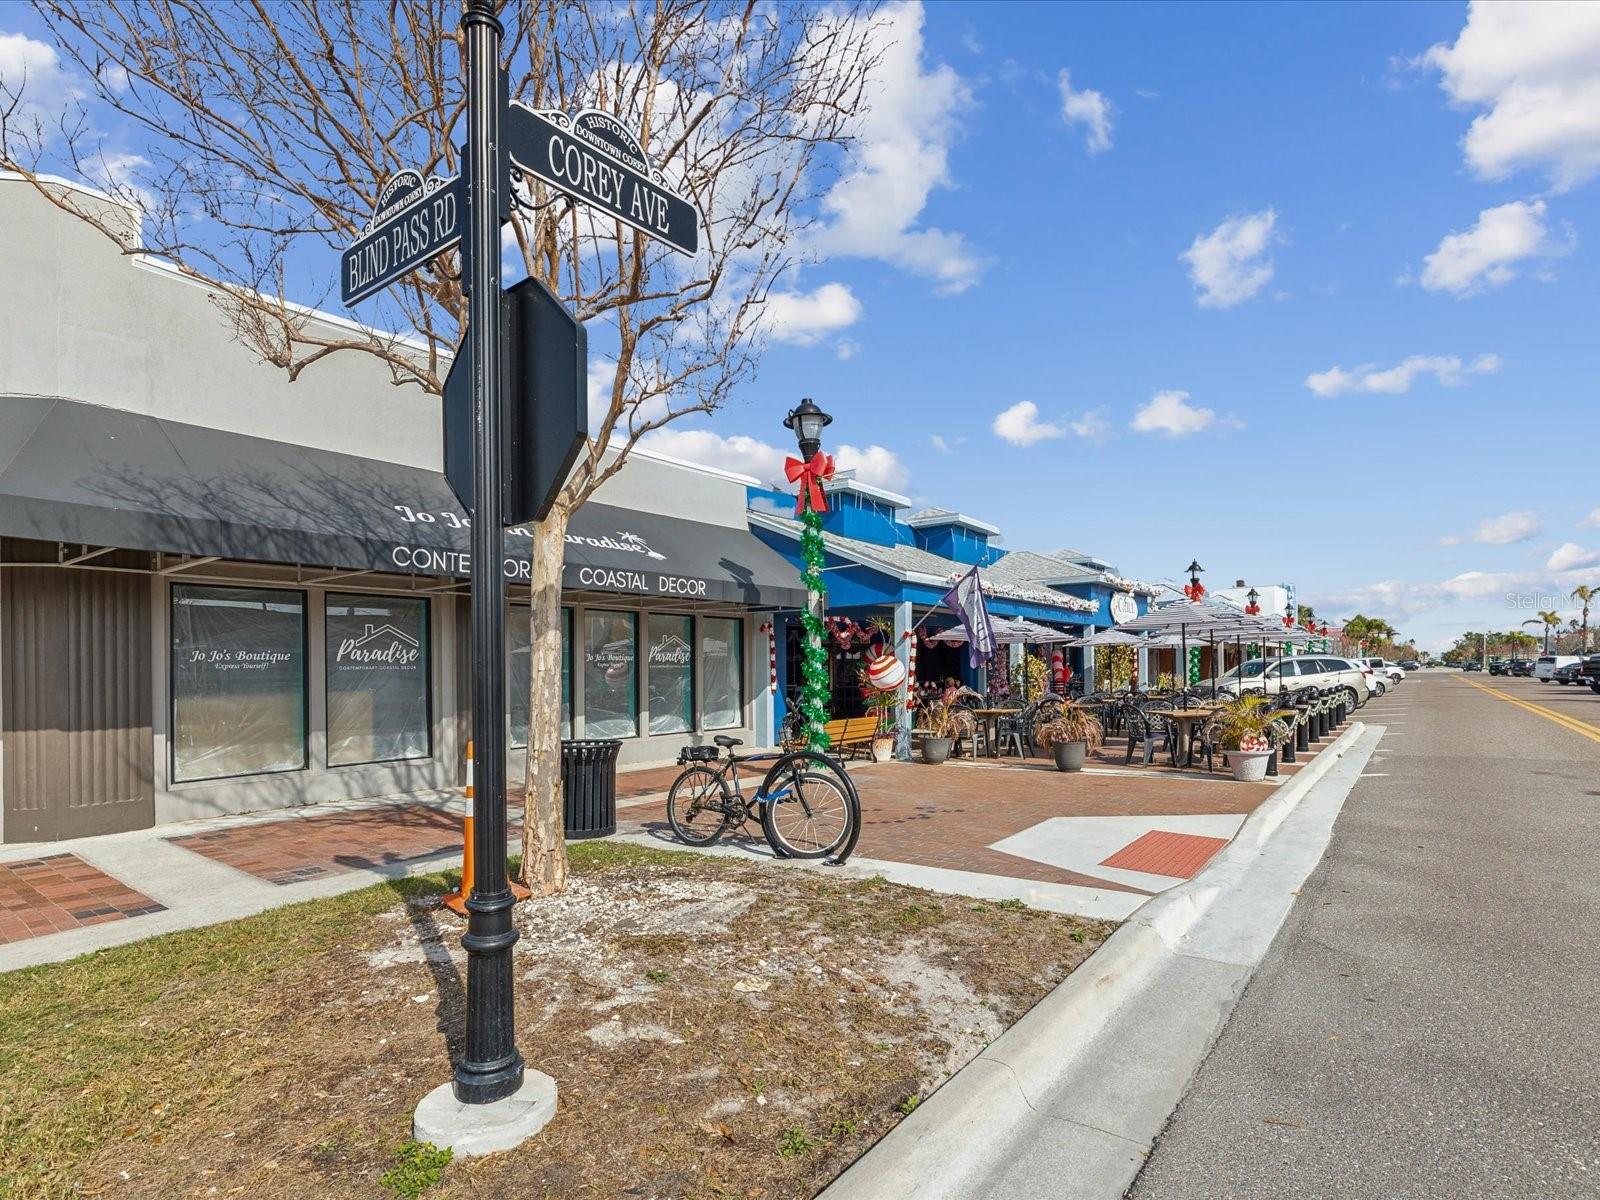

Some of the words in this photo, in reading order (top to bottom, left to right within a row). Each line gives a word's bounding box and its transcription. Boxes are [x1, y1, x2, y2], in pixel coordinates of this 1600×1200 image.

[576, 124, 621, 159] DOWNTOWN
[622, 152, 647, 174] COREY
[586, 115, 638, 155] HISTORIC
[381, 174, 417, 208] HISTORIC
[548, 135, 625, 210] COREY
[630, 182, 670, 234] AVE
[375, 198, 405, 226] DOWNTOWN
[349, 235, 390, 293] BLIND
[393, 207, 429, 267] PASS
[433, 192, 457, 243] RD
[394, 505, 436, 523] Jo
[579, 567, 649, 590] COASTAL
[659, 576, 706, 596] DECOR
[189, 650, 206, 662] Jo
[208, 649, 231, 662] Jo's
[235, 650, 291, 664] Boutique
[336, 638, 419, 664] Paradise
[648, 645, 691, 664] Paradise
